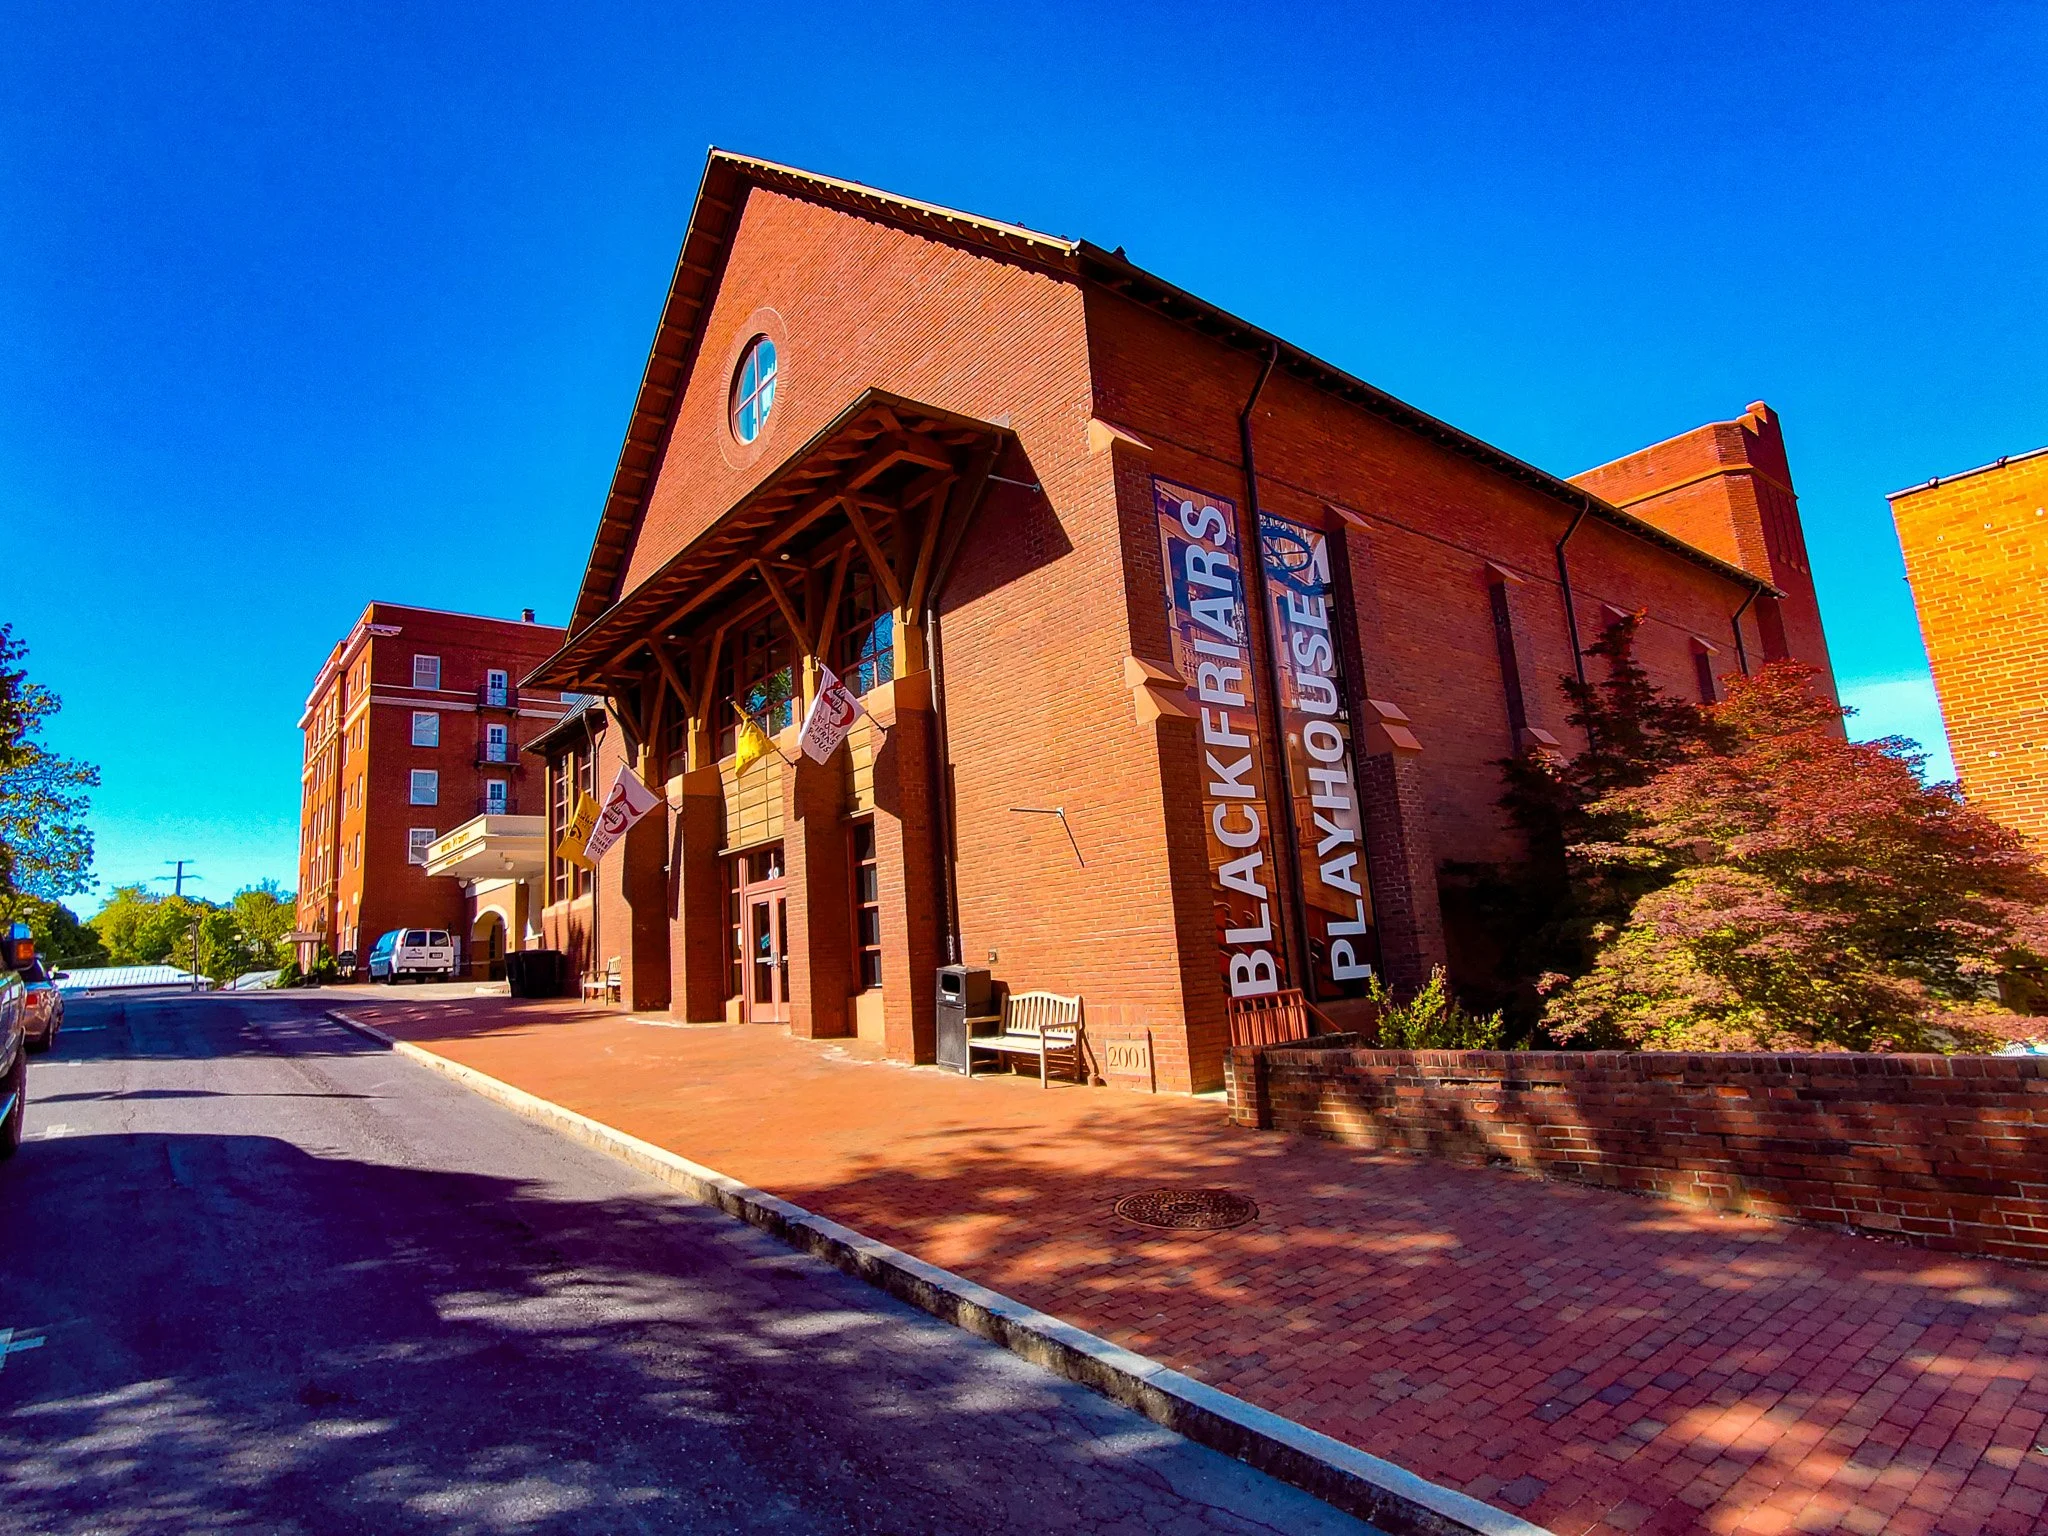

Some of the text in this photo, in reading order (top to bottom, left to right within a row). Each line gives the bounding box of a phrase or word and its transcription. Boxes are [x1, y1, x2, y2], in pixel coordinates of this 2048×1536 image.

[1180, 500, 1278, 998] BLACKFRIARS
[1287, 590, 1372, 981] PLAYHOUSE
[1108, 1046, 1146, 1068] 2001
